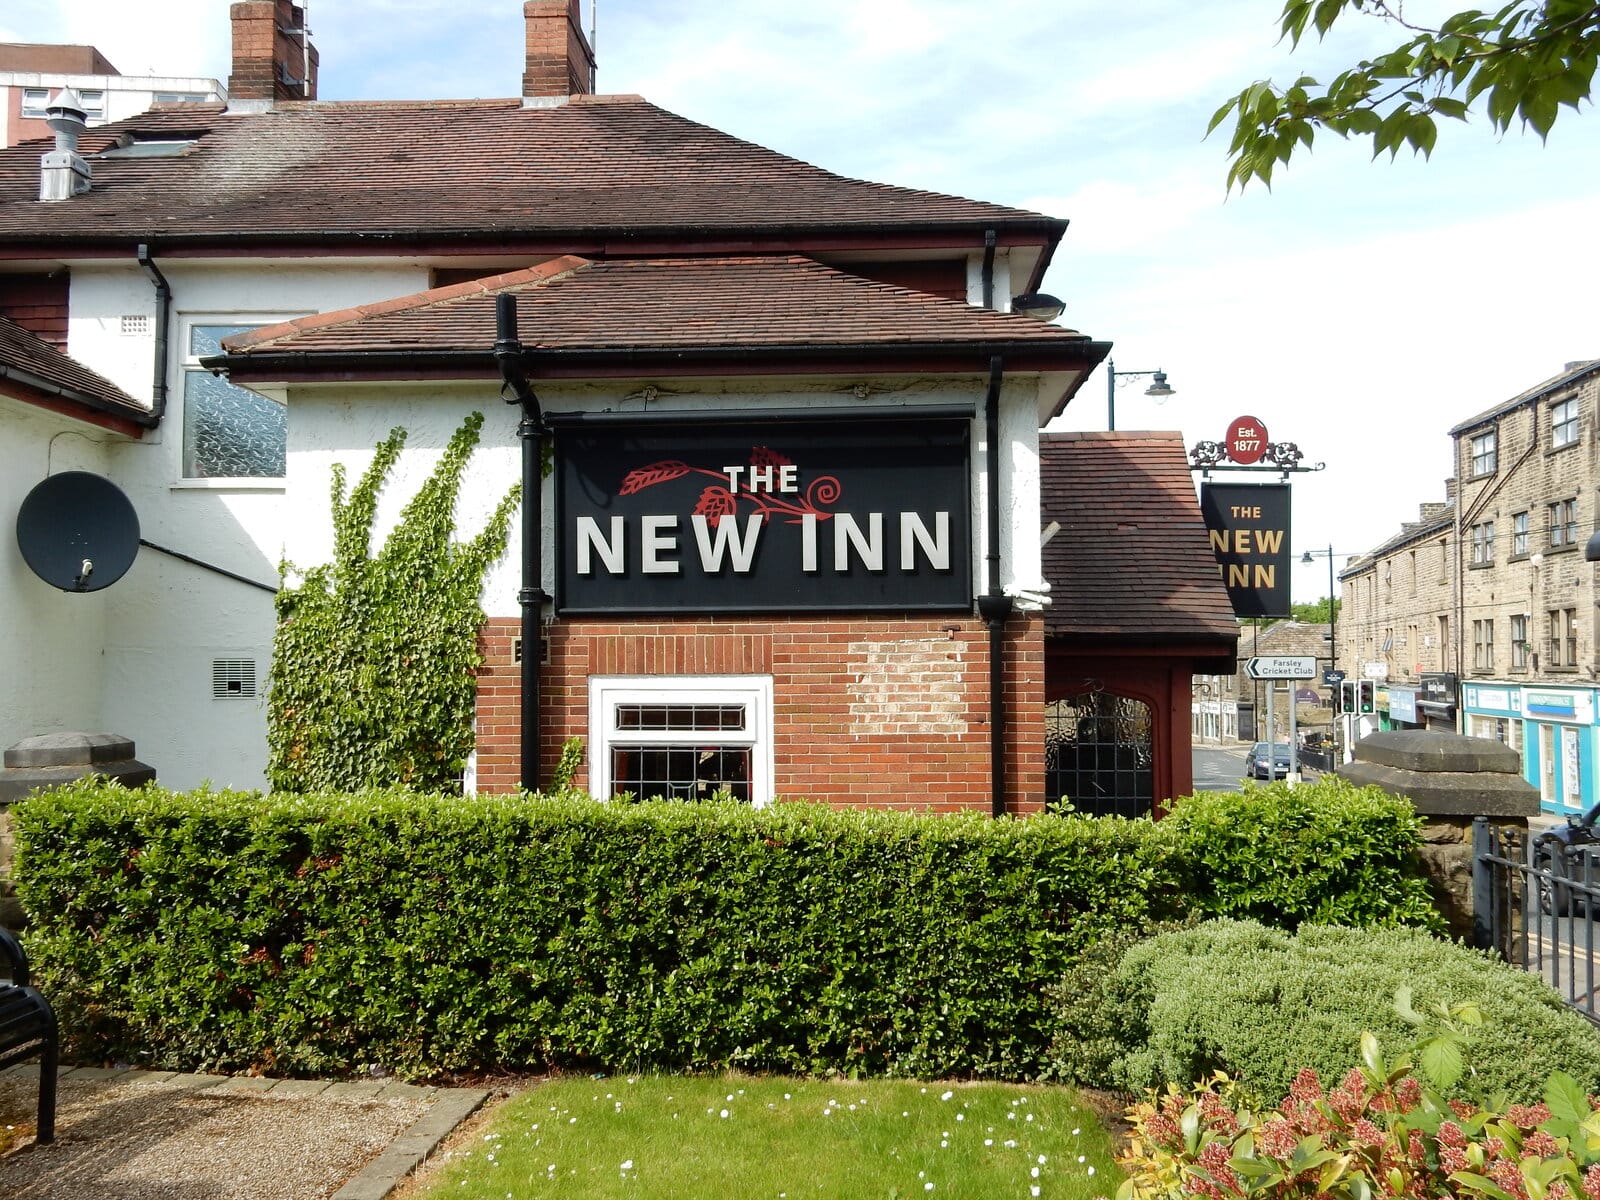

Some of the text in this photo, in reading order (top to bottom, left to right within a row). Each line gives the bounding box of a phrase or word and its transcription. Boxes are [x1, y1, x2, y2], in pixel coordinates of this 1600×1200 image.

[1238, 427, 1257, 437] Est.
[1233, 440, 1260, 452] 1877
[723, 465, 799, 493] THE
[1231, 506, 1262, 518] THE
[575, 511, 950, 574] NEW INN
[1209, 529, 1284, 555] NEW
[1273, 659, 1302, 667] Farsley
[1262, 667, 1313, 675] Cricket Club
